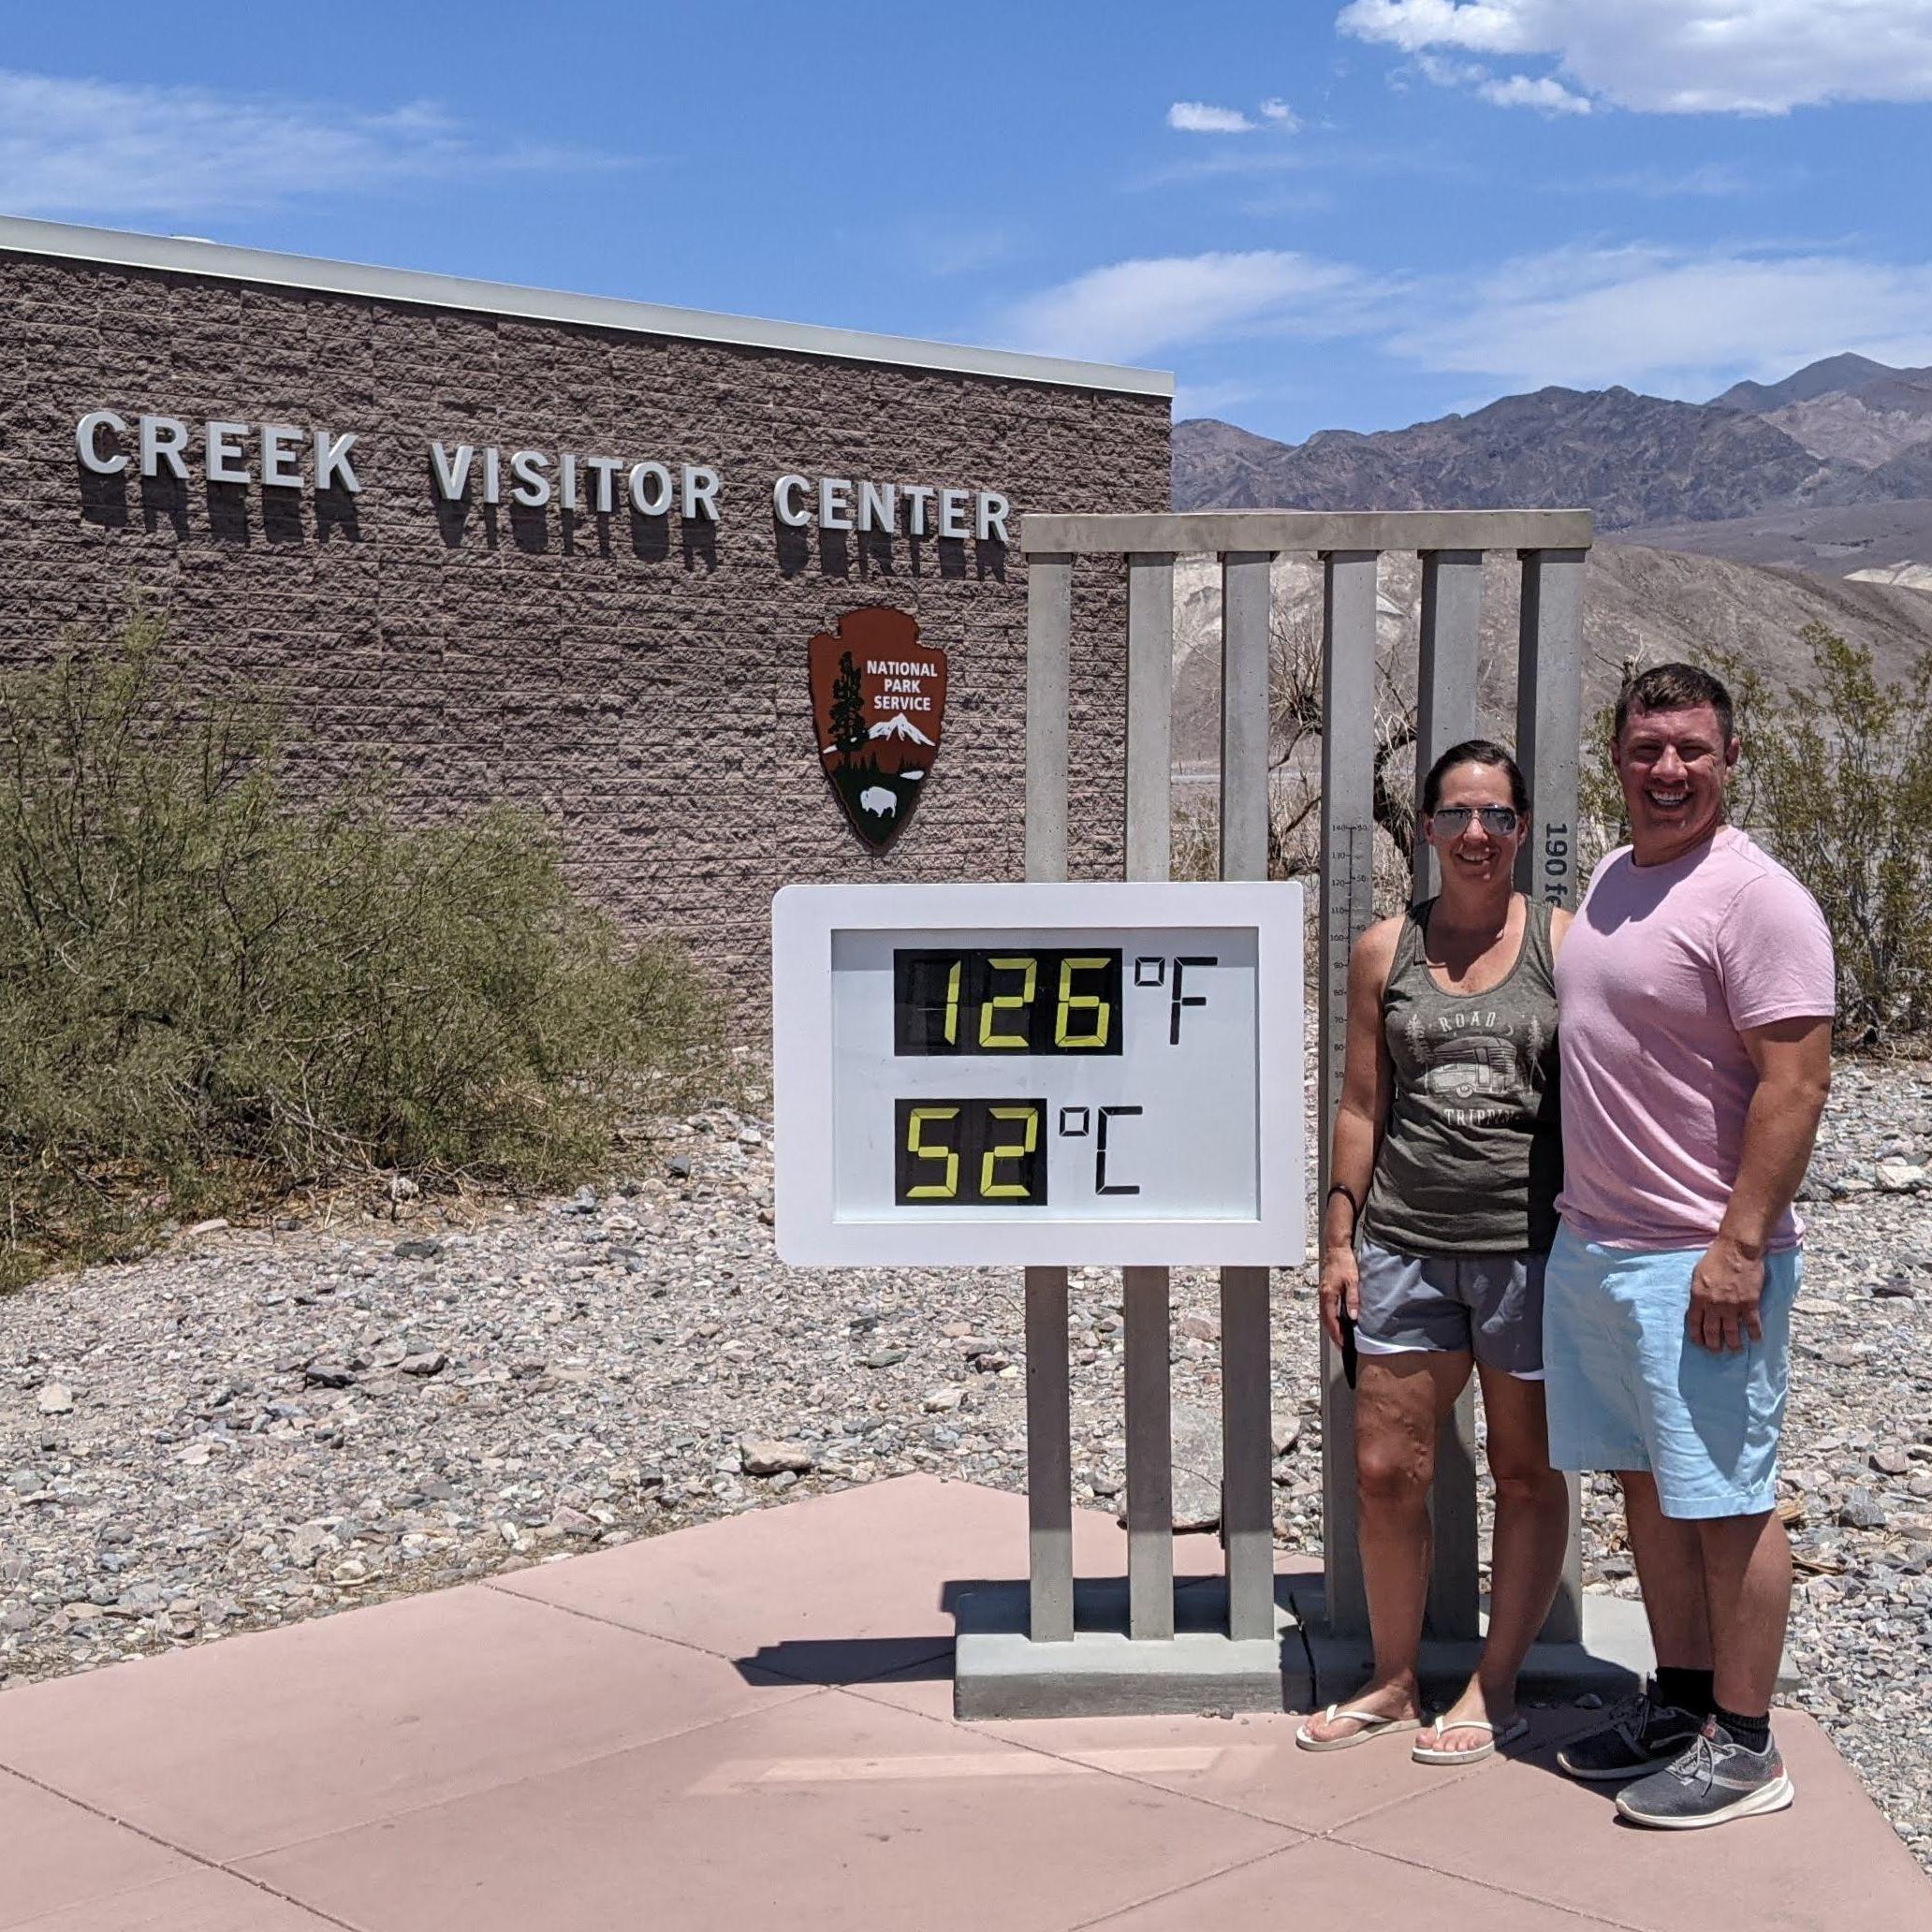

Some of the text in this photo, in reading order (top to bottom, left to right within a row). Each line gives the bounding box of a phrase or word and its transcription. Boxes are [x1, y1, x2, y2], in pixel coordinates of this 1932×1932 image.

[76, 411, 1012, 542] CREEK VISITOR CENTER
[867, 660, 938, 678] NATIONAL
[884, 678, 921, 694] PARK
[873, 695, 931, 711] SERVICE
[1544, 823, 1568, 908] 190 fe
[1332, 879, 1345, 887] 120
[1331, 906, 1345, 915] 110
[944, 957, 1112, 1048] 126
[1437, 1011, 1497, 1032] ROAD
[905, 1106, 1039, 1198] 52
